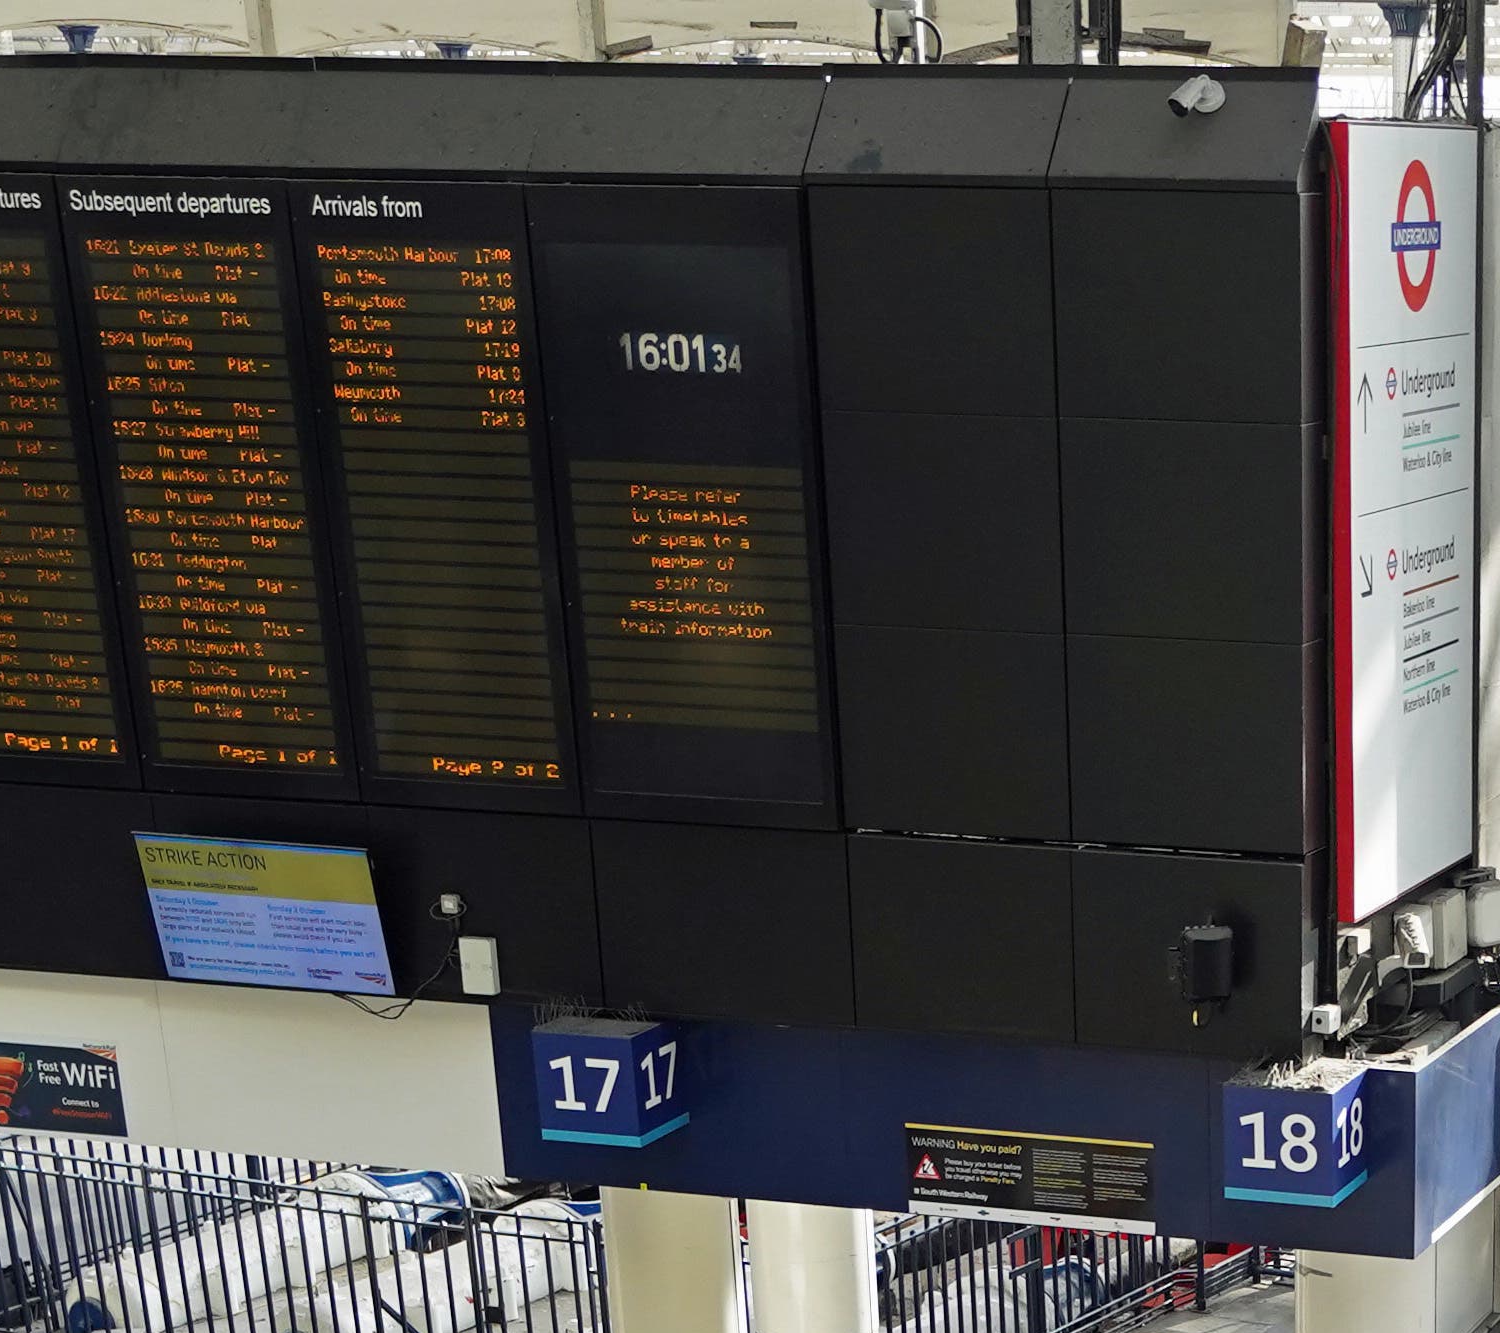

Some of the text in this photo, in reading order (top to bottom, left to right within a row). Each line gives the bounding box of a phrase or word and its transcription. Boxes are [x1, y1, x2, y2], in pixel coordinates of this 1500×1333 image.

[69, 189, 271, 218] Subsequent departures
[311, 194, 423, 218] Arrivals from
[1393, 225, 1439, 247] UNDERGROUND
[1401, 362, 1456, 397] Underground
[1402, 419, 1432, 439] Jubilee line
[1403, 453, 1425, 473] Waterloo
[1431, 451, 1443, 470] City
[1443, 449, 1452, 462] line
[630, 484, 741, 504] Please refer
[658, 532, 706, 550] speak
[1402, 534, 1455, 575] Underground
[1403, 596, 1435, 618] Bakerloo line
[674, 619, 772, 639] information
[1403, 629, 1431, 651] Jubilee line
[1403, 659, 1435, 682] Northern line
[1403, 693, 1426, 715] Waterloo
[1431, 687, 1441, 705] City
[1442, 684, 1451, 696] line
[144, 847, 267, 871] STRIKE ACTION
[37, 1060, 116, 1090] Fast WiFi
[39, 1073, 61, 1085] Free
[549, 1056, 619, 1112] 17
[640, 1041, 676, 1110] 17
[62, 1097, 92, 1107] Connect
[1240, 1112, 1318, 1172] 18
[1337, 1097, 1363, 1168] 18
[911, 1136, 1022, 1155] WARNING Have you paid?
